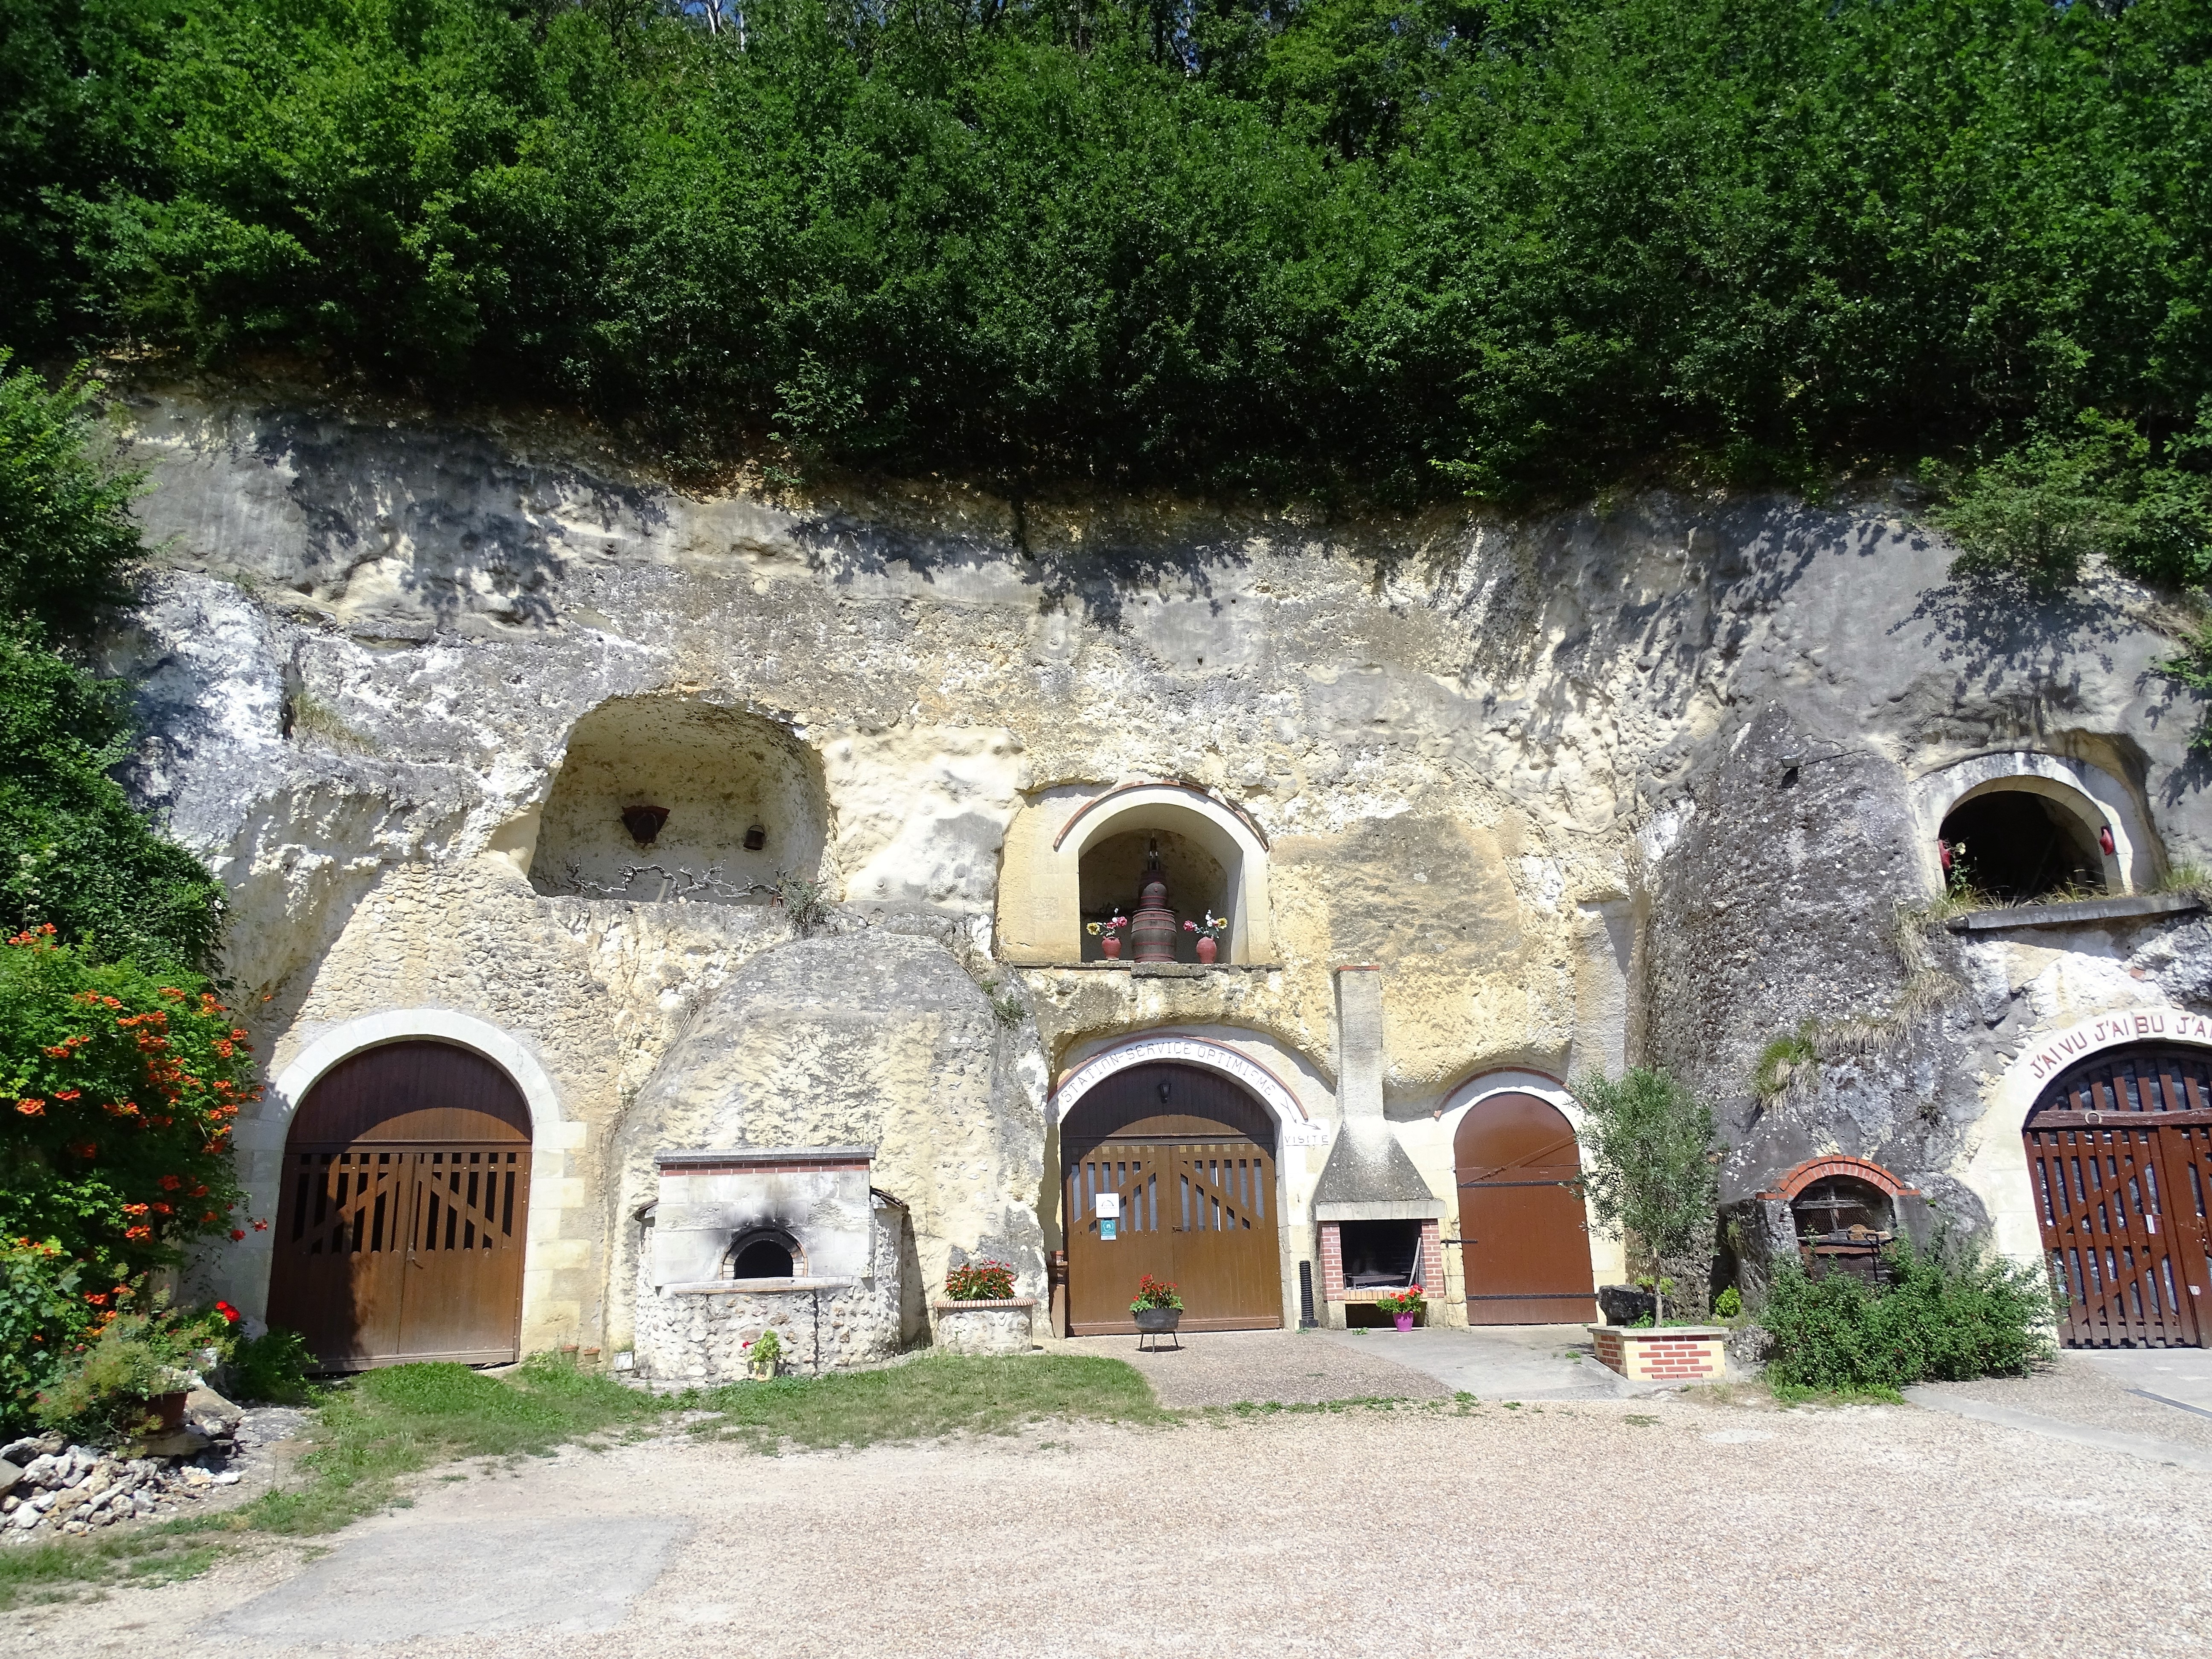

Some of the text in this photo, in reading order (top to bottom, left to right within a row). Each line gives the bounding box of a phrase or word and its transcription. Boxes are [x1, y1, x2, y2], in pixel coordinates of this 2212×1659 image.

[1061, 1042, 1275, 1102] STATION-SERVICE OPTIMISME
[2030, 1047, 2062, 1079] J'AI
[2058, 1031, 2087, 1054] VU
[2094, 1018, 2129, 1041] J'AI
[2134, 1015, 2164, 1033] BU
[1284, 1135, 1329, 1144] VISITE
